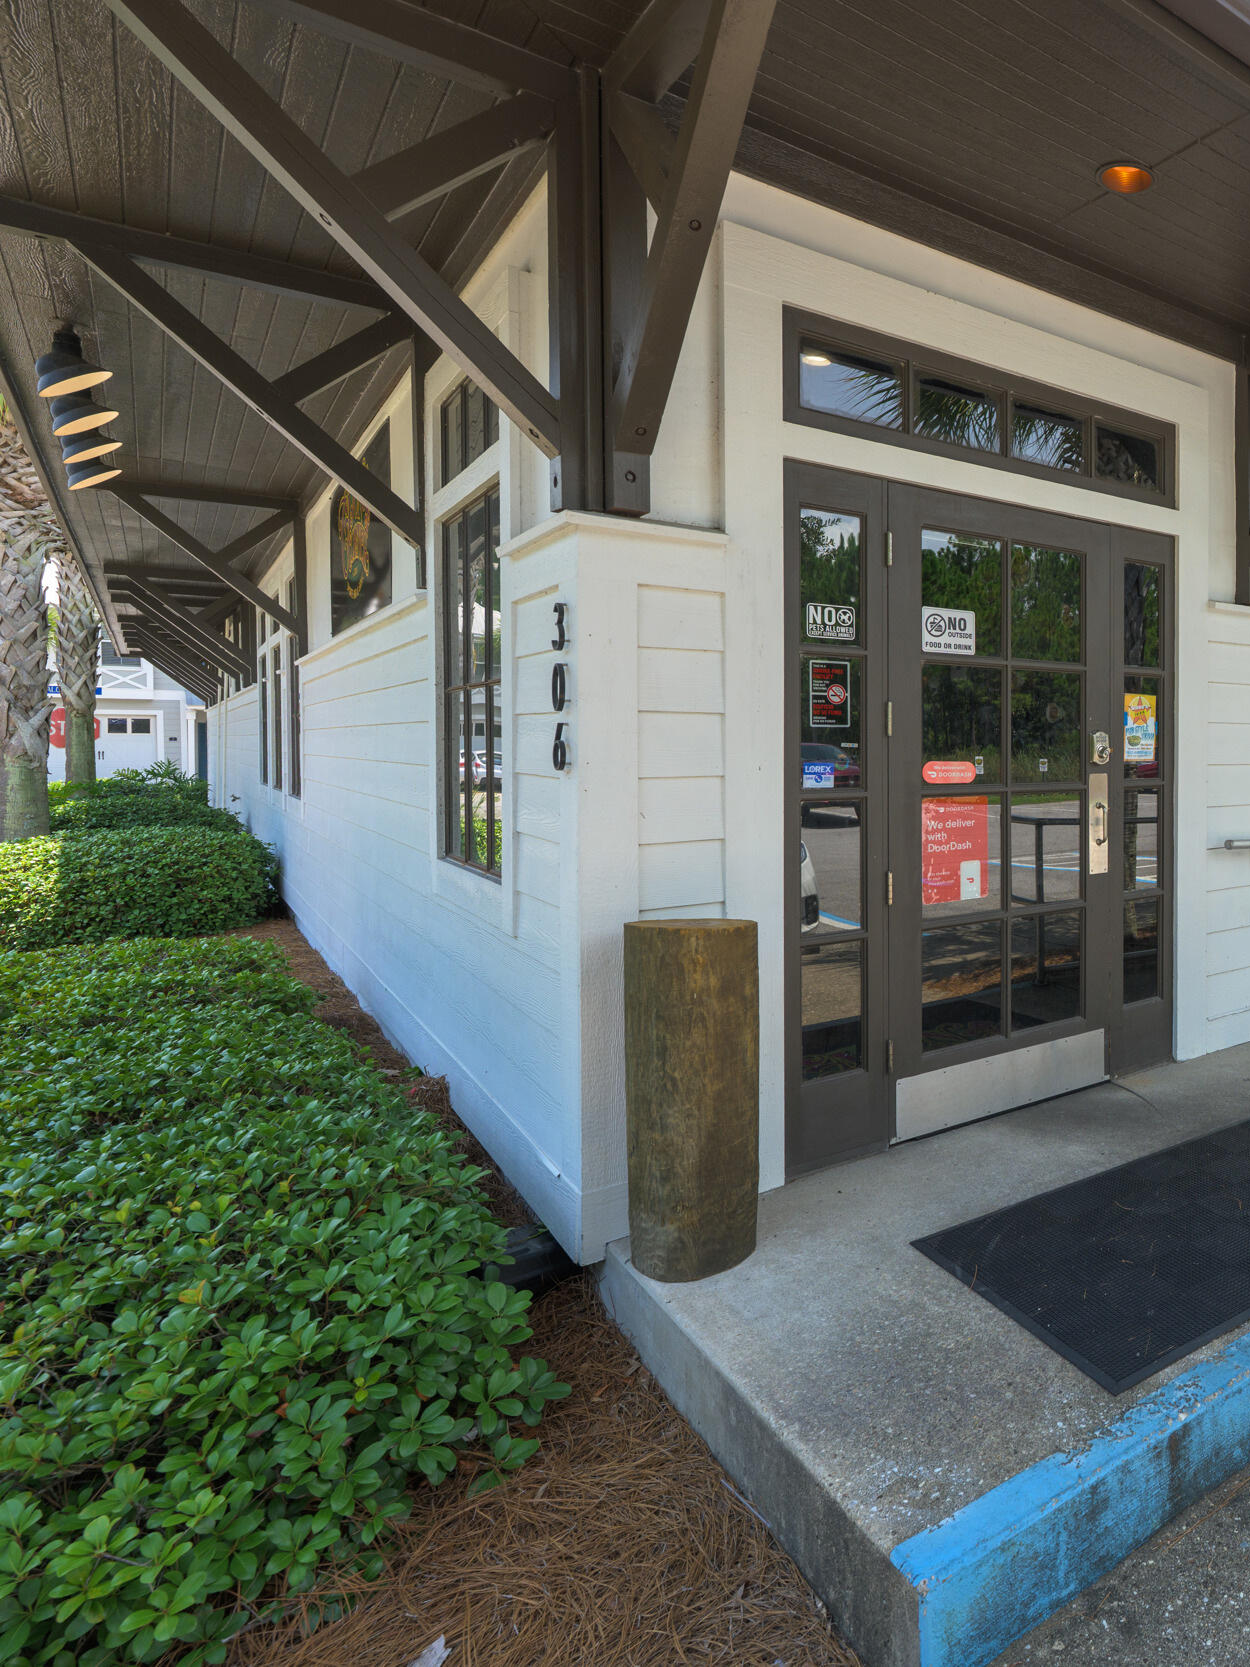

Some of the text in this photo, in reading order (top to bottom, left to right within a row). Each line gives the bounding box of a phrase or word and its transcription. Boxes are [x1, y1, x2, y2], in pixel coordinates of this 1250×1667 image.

[809, 605, 836, 625] NO
[809, 624, 853, 634] PETS ALLOWED
[947, 616, 967, 631] NO
[925, 641, 942, 649] FOOD
[953, 643, 972, 651] DRINK
[552, 602, 566, 771] 306
[805, 765, 832, 773] LOREX
[927, 818, 975, 830] We deliver
[927, 831, 947, 841] with
[927, 840, 972, 853] DoorDash
